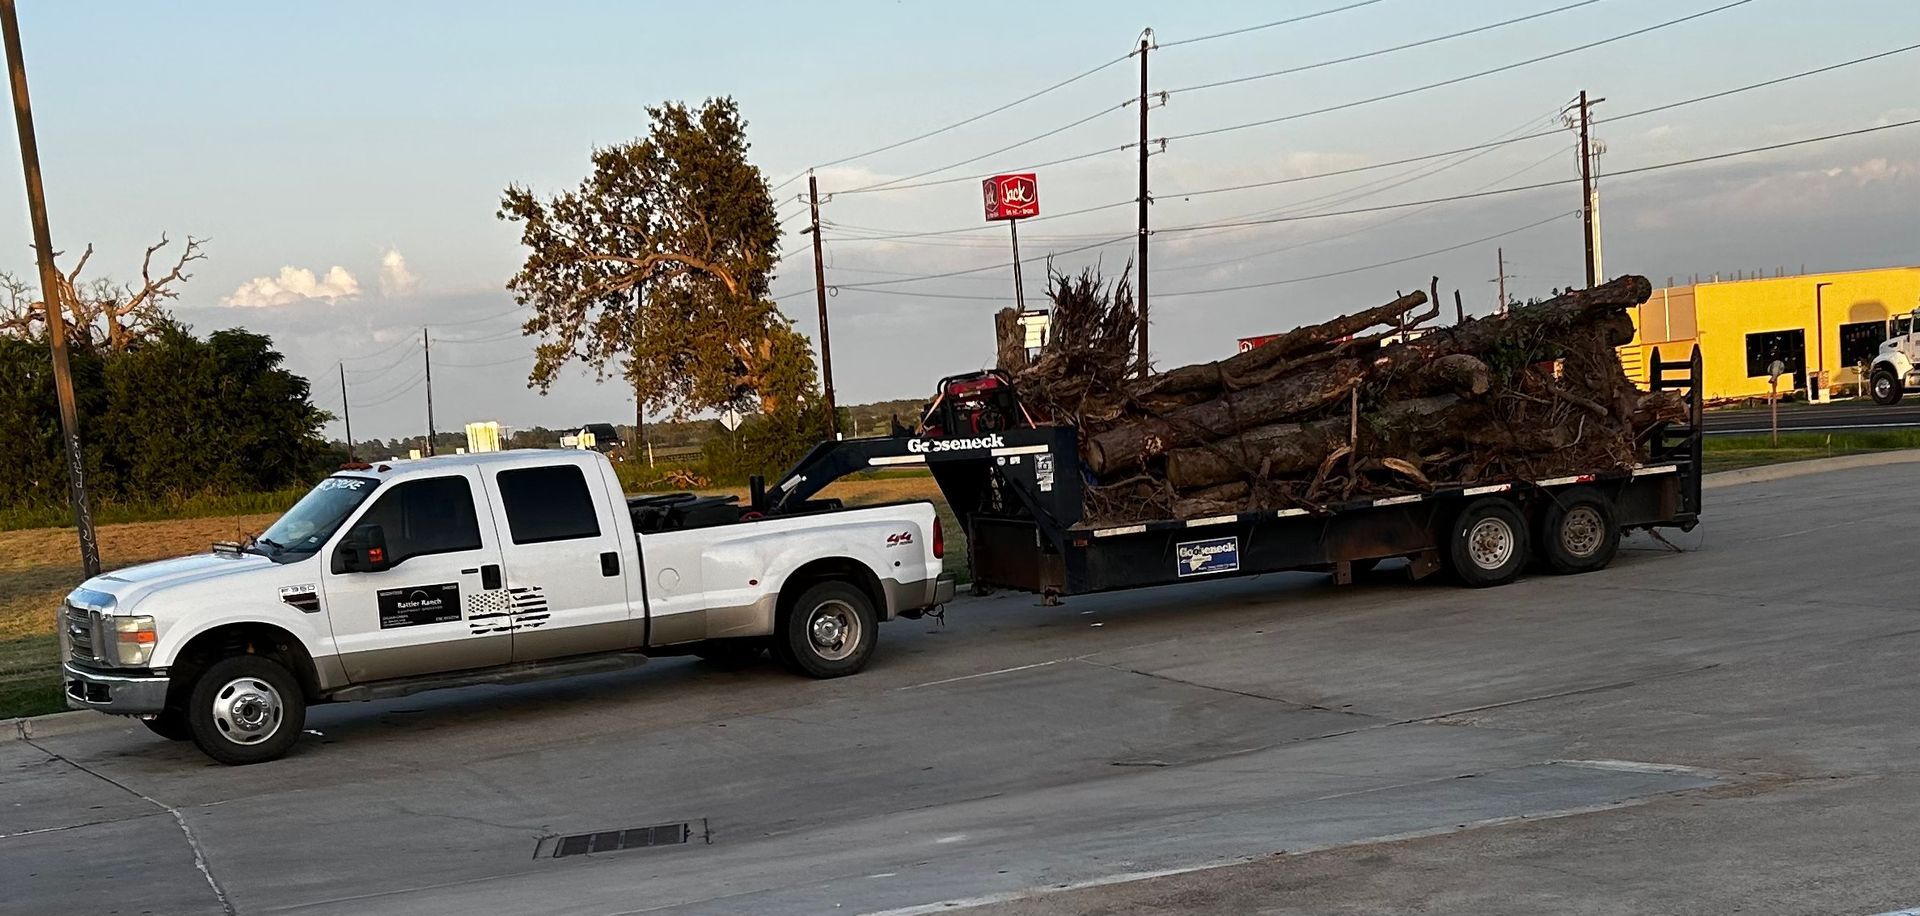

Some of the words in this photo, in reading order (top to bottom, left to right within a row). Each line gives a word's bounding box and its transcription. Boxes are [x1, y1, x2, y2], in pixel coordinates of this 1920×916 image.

[1003, 180, 1033, 203] Jack
[907, 433, 1005, 453] Gooseneck
[1179, 542, 1236, 557] Gooseneck
